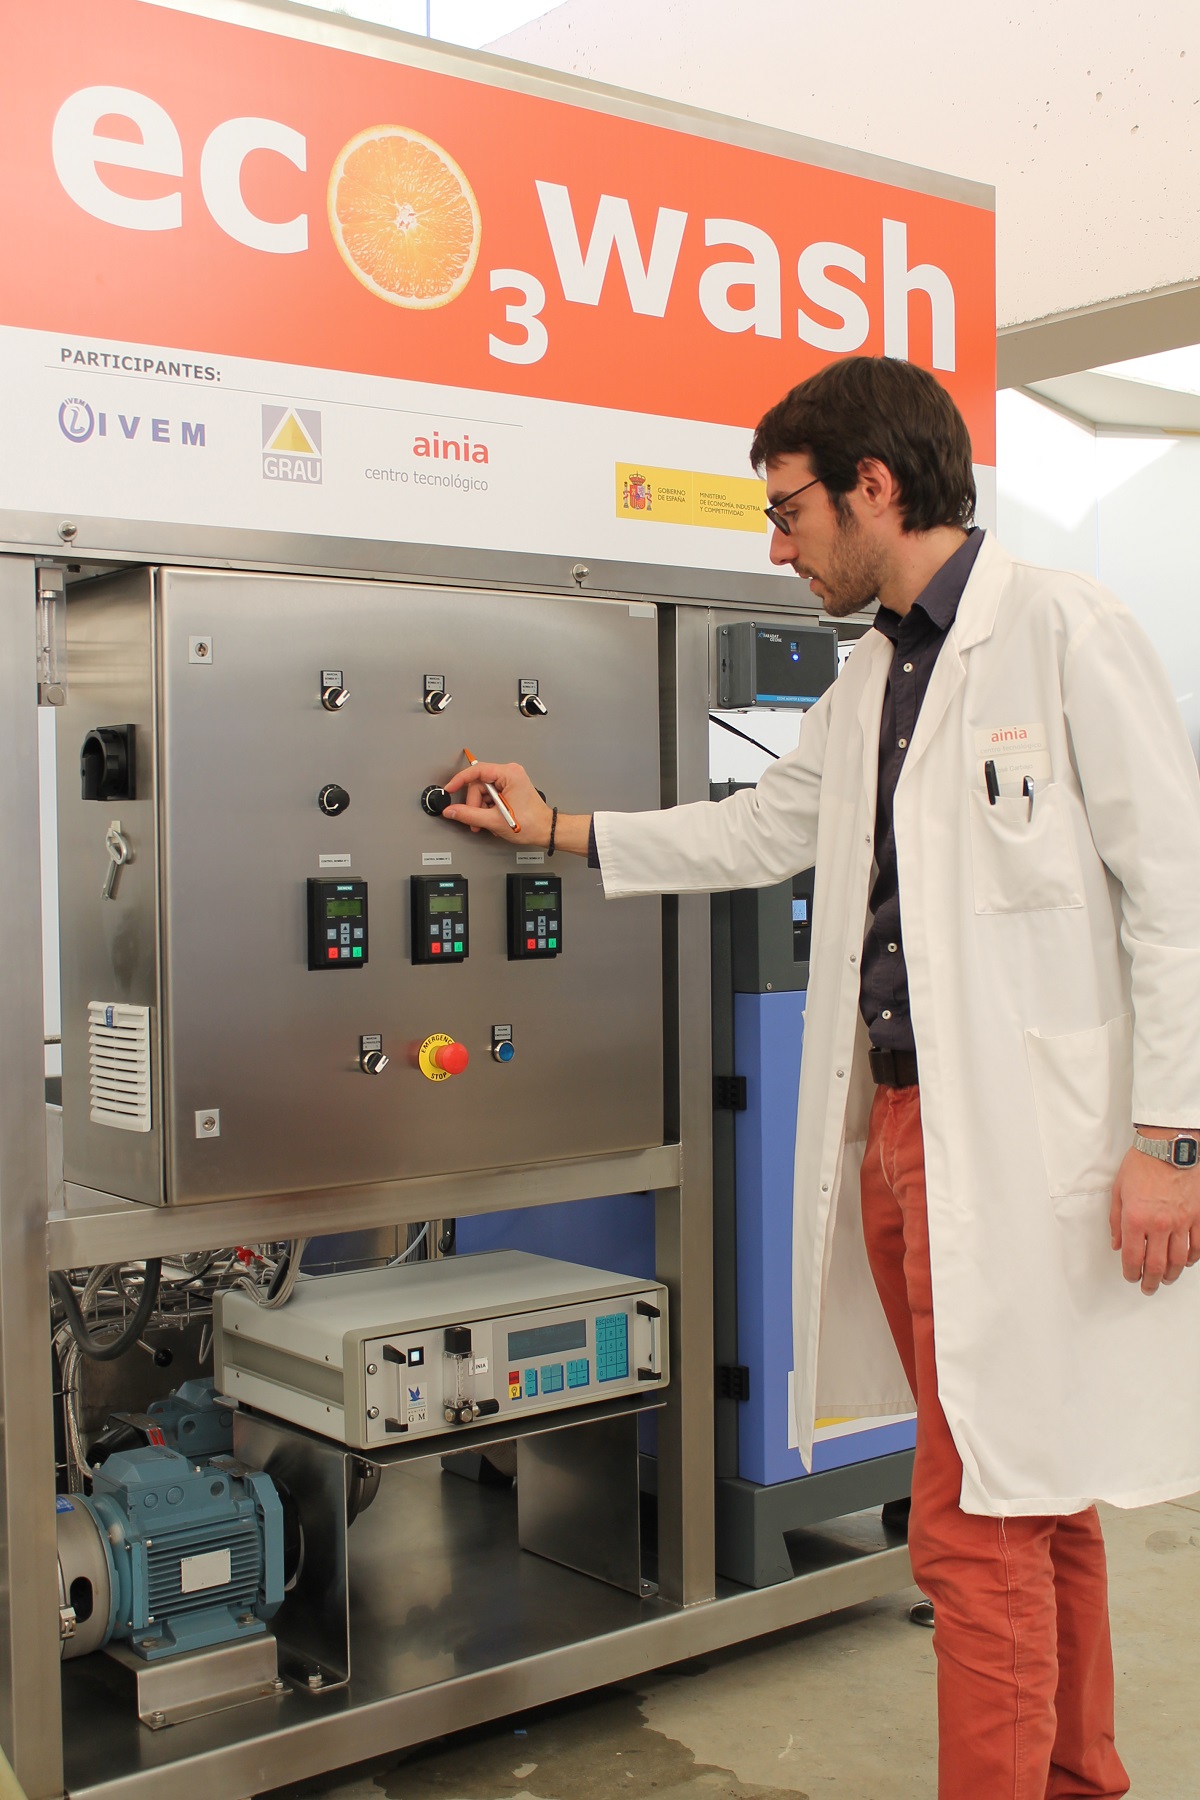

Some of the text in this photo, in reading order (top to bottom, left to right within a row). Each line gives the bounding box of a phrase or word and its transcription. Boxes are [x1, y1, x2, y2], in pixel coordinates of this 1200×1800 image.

[535, 179, 956, 373] wash
[60, 348, 222, 382] PARTICIPANTES:
[98, 412, 207, 447] IVEM
[412, 430, 490, 464] ainia
[263, 456, 321, 482] GRAU
[365, 467, 489, 492] centro tecnológico
[657, 487, 686, 496] GOBIERNO
[666, 494, 686, 503] ESPAÑA
[699, 492, 727, 501] MINISTERIO
[704, 507, 745, 517] COMPETITIVIDAD
[735, 503, 761, 512] INDUSTRIA
[991, 727, 1028, 743] ainia
[421, 1034, 453, 1054] EMERGENC
[430, 1071, 447, 1080] STOP
